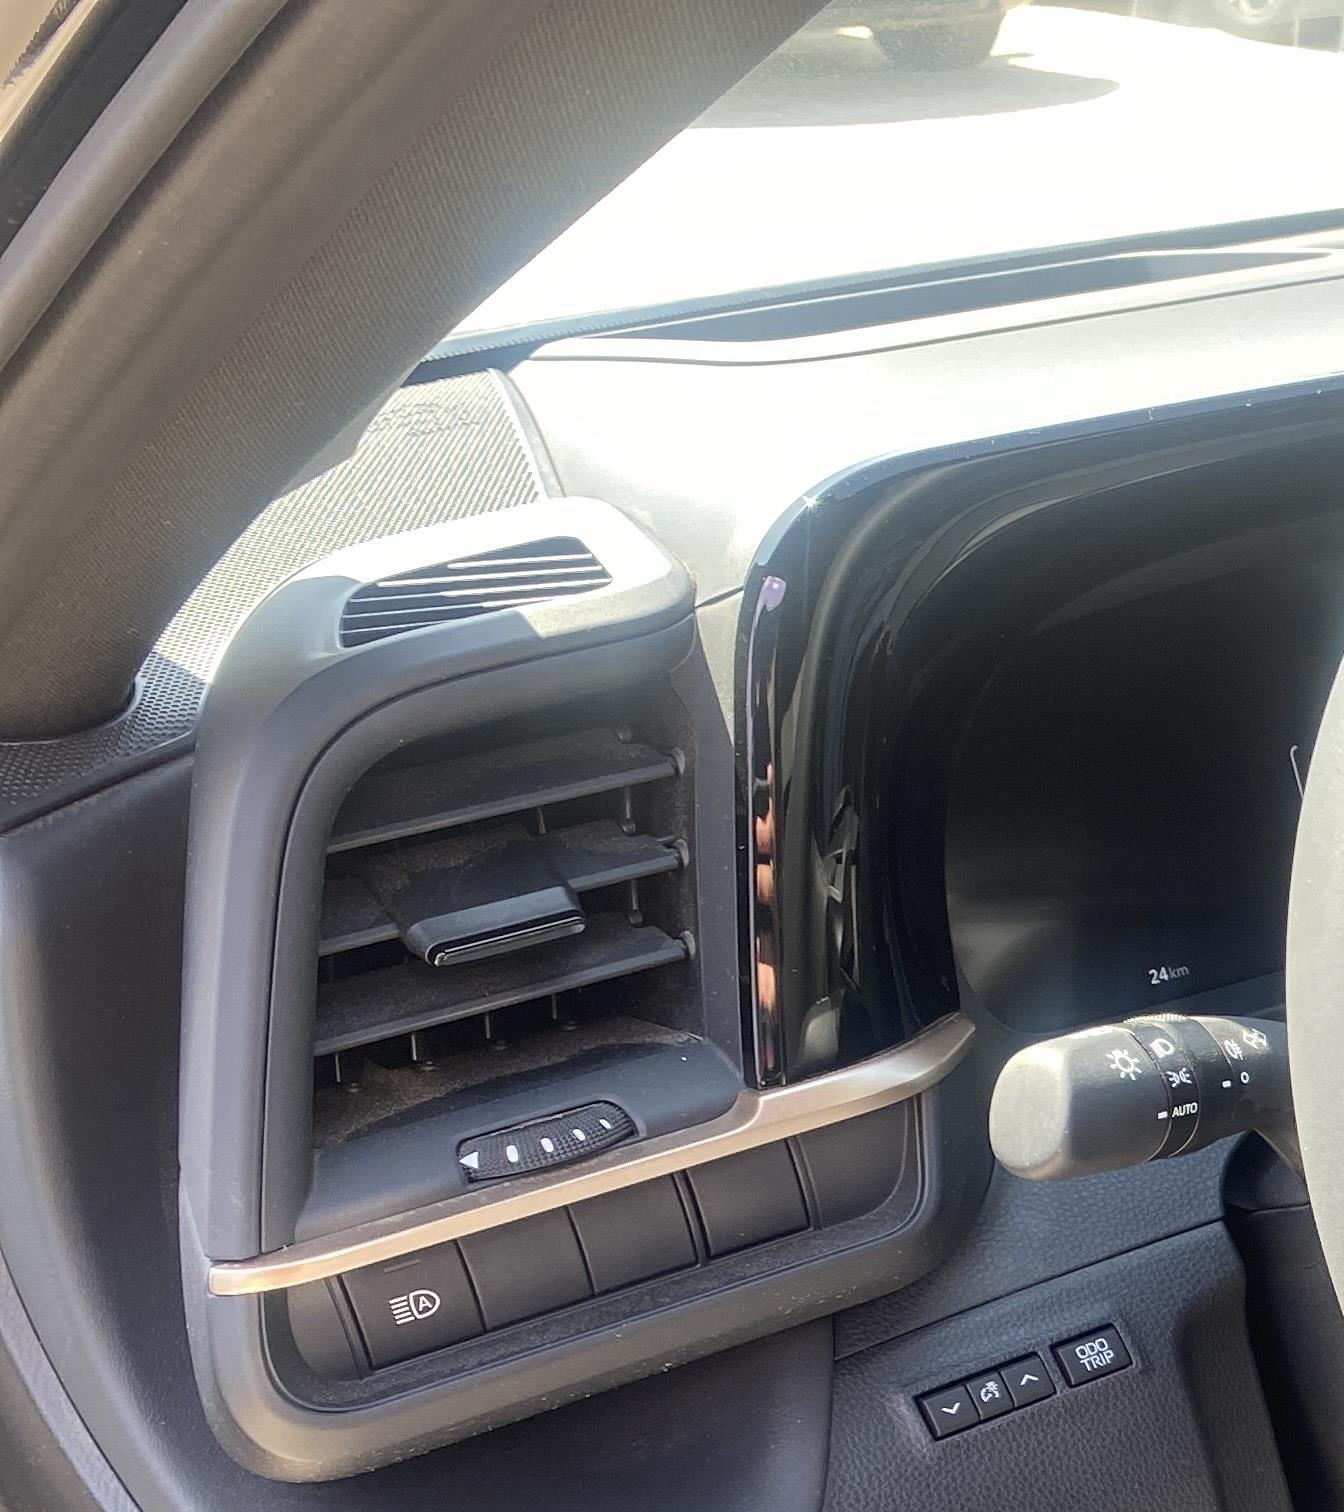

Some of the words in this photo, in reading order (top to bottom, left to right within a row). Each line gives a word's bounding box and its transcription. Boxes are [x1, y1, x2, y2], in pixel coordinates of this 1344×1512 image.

[1171, 1102, 1198, 1118] AUTO
[1075, 1337, 1109, 1359] ODO
[1080, 1349, 1114, 1371] TRIP
